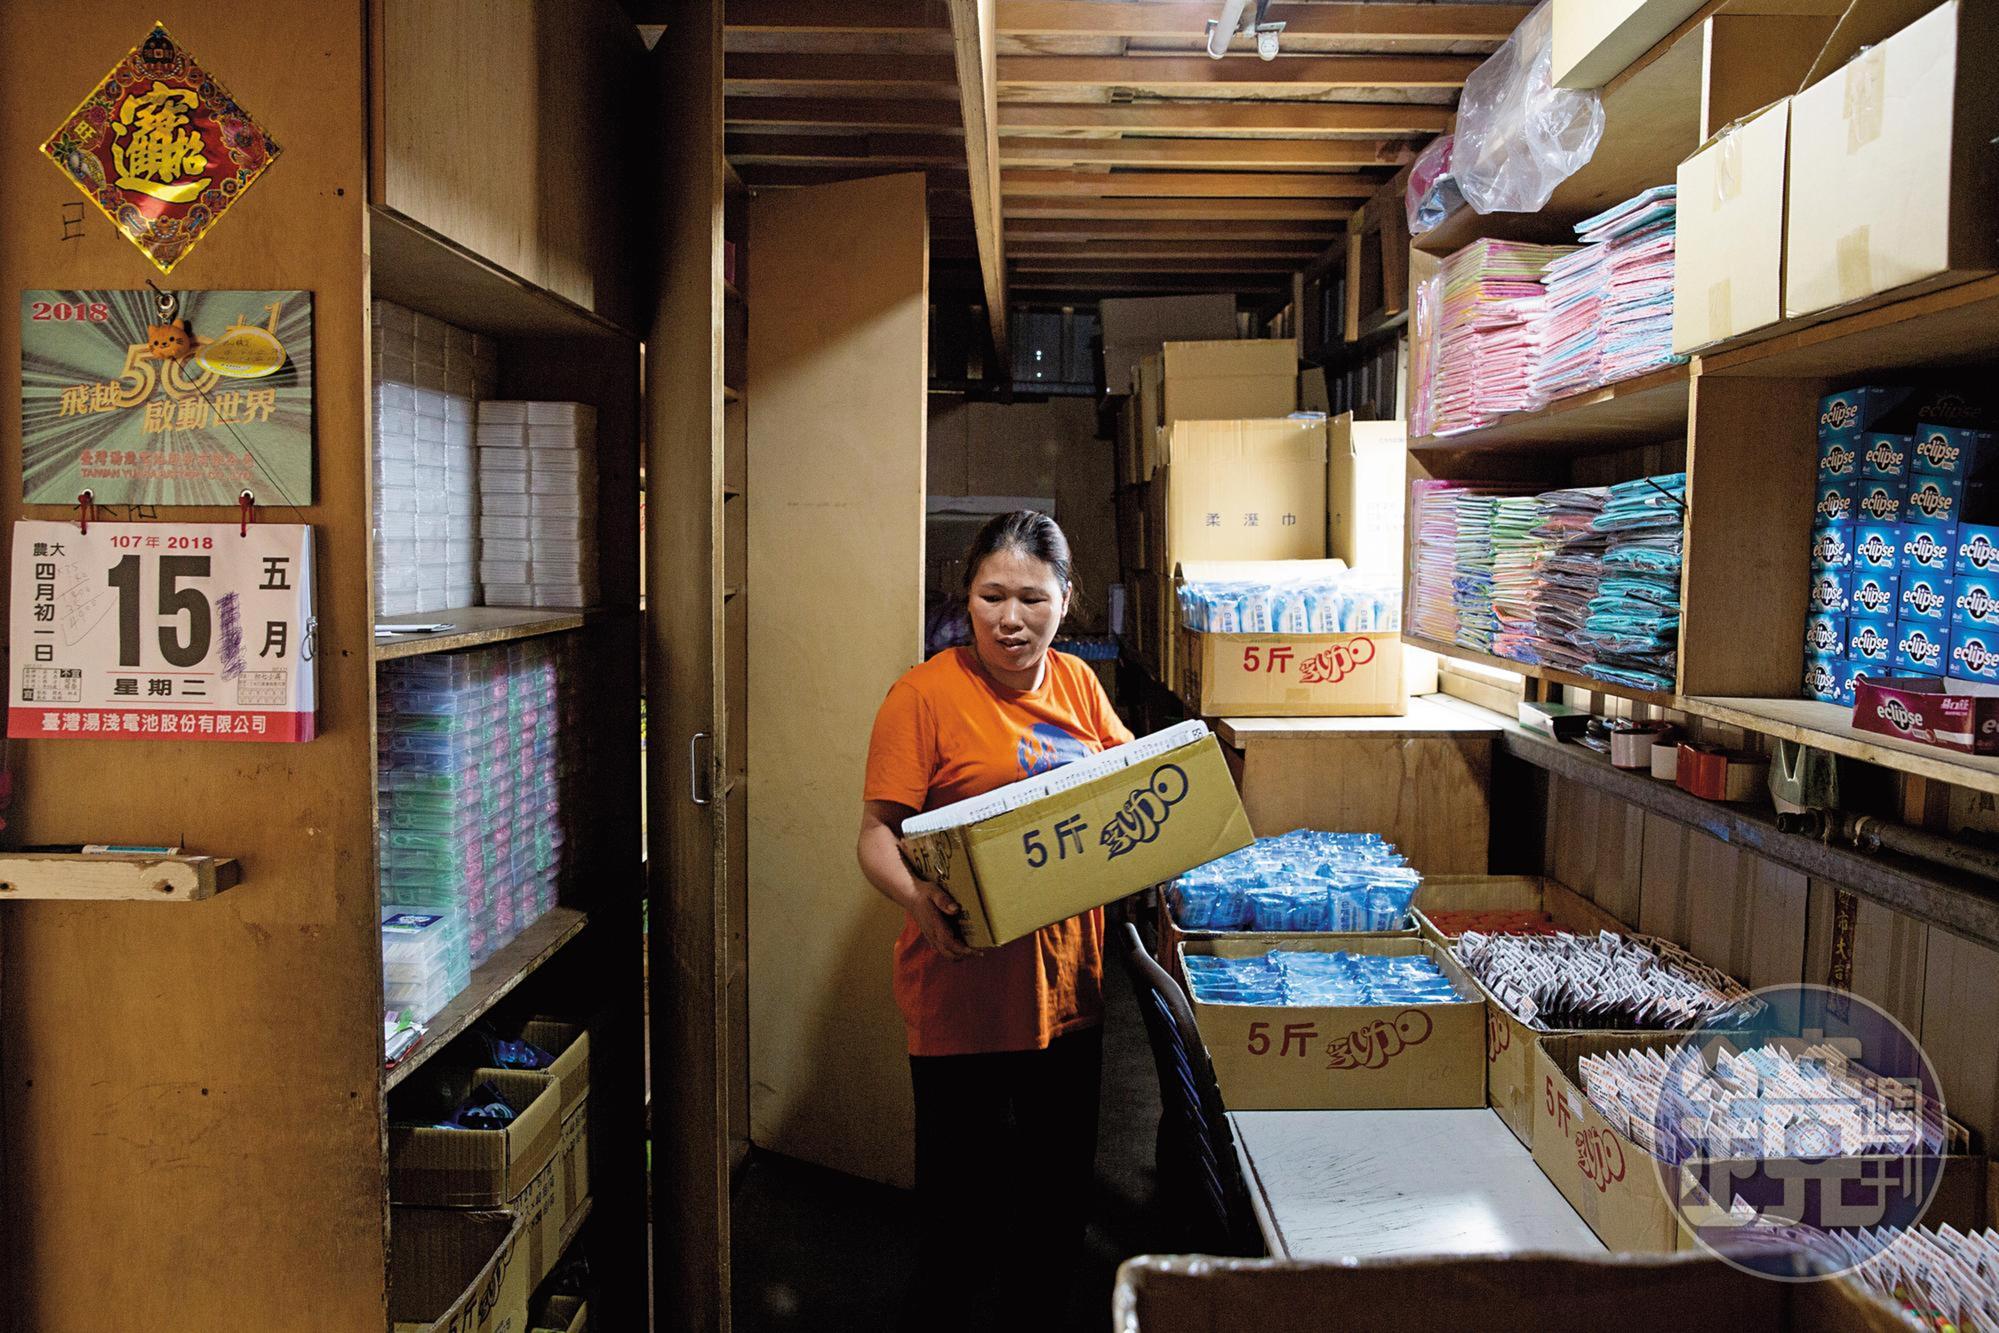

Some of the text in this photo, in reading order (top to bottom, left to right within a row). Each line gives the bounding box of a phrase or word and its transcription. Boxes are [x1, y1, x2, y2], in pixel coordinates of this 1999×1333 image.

[31, 302, 109, 322] 2018
[59, 381, 122, 417] 飛越
[142, 388, 277, 435] 啟動世界
[1821, 404, 1858, 426] eclipse
[1820, 450, 1855, 471] eclipse
[1865, 446, 1904, 469] eclipse
[1917, 439, 1960, 463] eclipse
[1817, 496, 1851, 516] eclipse
[1861, 495, 1899, 517] eclipse
[1910, 490, 1952, 514] eclipse
[110, 535, 213, 550] 107年 2018
[1813, 540, 1845, 560] eclipse
[1857, 540, 1895, 561] eclipse
[1904, 540, 1947, 561] eclipse
[1812, 583, 1843, 604] eclipse
[1854, 587, 1891, 608] eclipse
[1903, 588, 1945, 611] eclipse
[33, 562, 56, 663] 四月初一日
[108, 554, 211, 668] 15
[258, 556, 291, 659] 五月
[1807, 625, 1837, 647] eclipse
[1851, 632, 1889, 655] eclipse
[1243, 646, 1294, 673] 5斤
[1899, 637, 1941, 661] eclipse
[1953, 644, 1999, 669] eclipse
[113, 678, 207, 697] 星期二
[1805, 667, 1835, 690] eclipse
[42, 712, 267, 734] 臺灣湯淺電池股份有限公司
[1877, 703, 1923, 728] eclipse
[1023, 814, 1088, 868] 5斤
[1248, 1023, 1318, 1057] 5斤
[1546, 1075, 1571, 1138] 5斤
